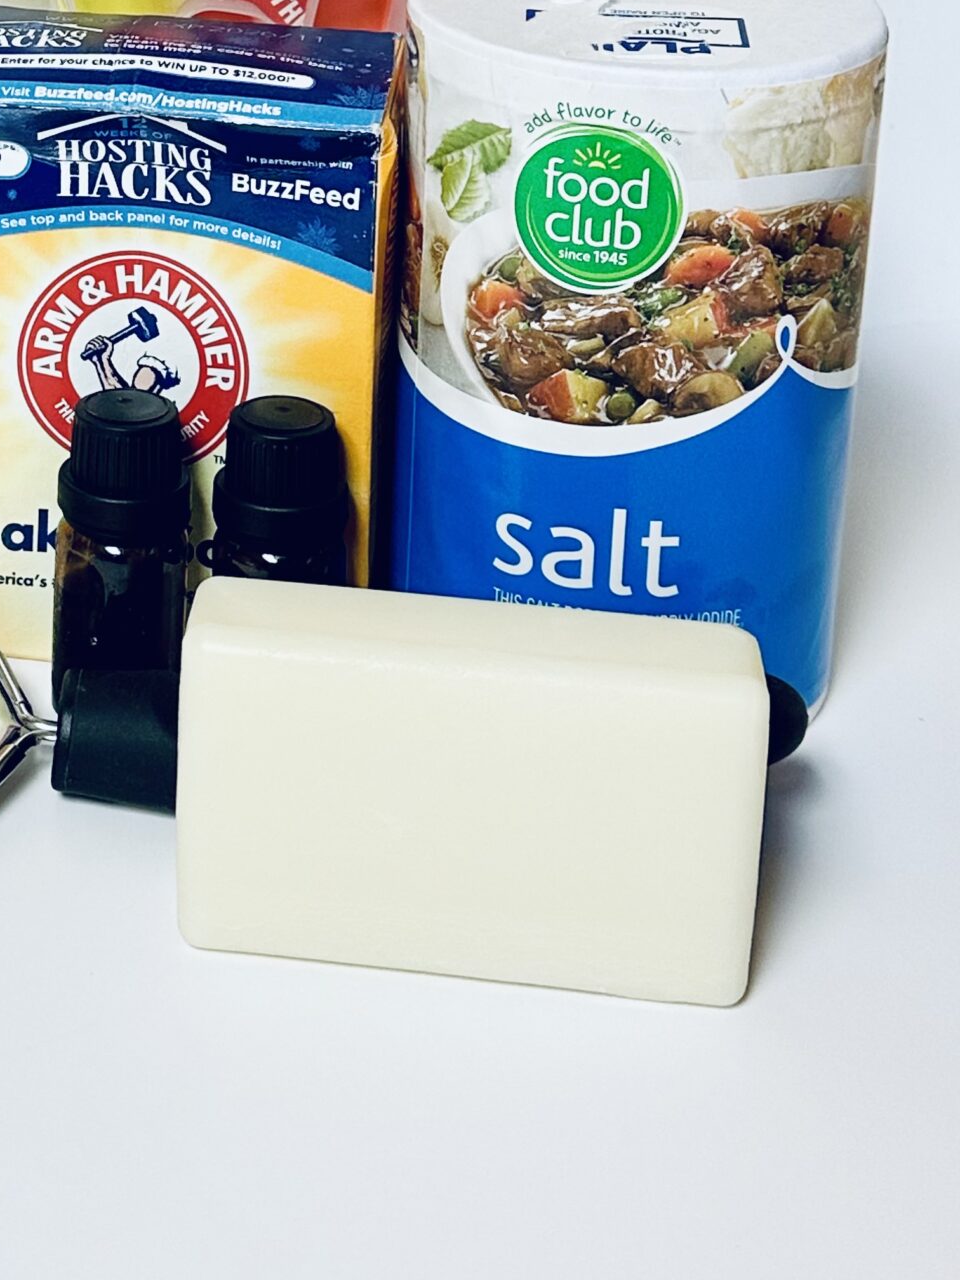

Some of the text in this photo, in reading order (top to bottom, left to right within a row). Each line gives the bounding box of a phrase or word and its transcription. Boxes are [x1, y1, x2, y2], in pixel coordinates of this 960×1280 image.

[122, 42, 160, 50] learn
[163, 45, 202, 54] more
[217, 47, 254, 57] code
[280, 56, 305, 65] the
[308, 61, 344, 72] back
[1, 57, 35, 65] Enter
[39, 57, 56, 65] for
[59, 58, 88, 67] your
[92, 58, 136, 67] chance
[158, 60, 186, 72] WIN
[190, 61, 208, 73] UP
[212, 65, 230, 76] TO
[1, 86, 282, 117] Visit Buzzfeed.com/HostingHacks
[524, 108, 553, 134] add
[556, 101, 617, 121] flavor
[622, 109, 643, 128] to
[94, 129, 173, 141] WEEKS OF
[55, 139, 212, 171] HOSTING
[246, 155, 353, 170] In partnership with
[56, 160, 212, 207] HACKS
[231, 172, 361, 211] BuzzFeed
[543, 156, 651, 210] food
[0, 209, 282, 251] See top and back panel for more details!
[544, 203, 642, 250] club
[558, 247, 628, 266] since 1945
[31, 264, 235, 392] ARM & HAMMER
[492, 508, 680, 598] salt
